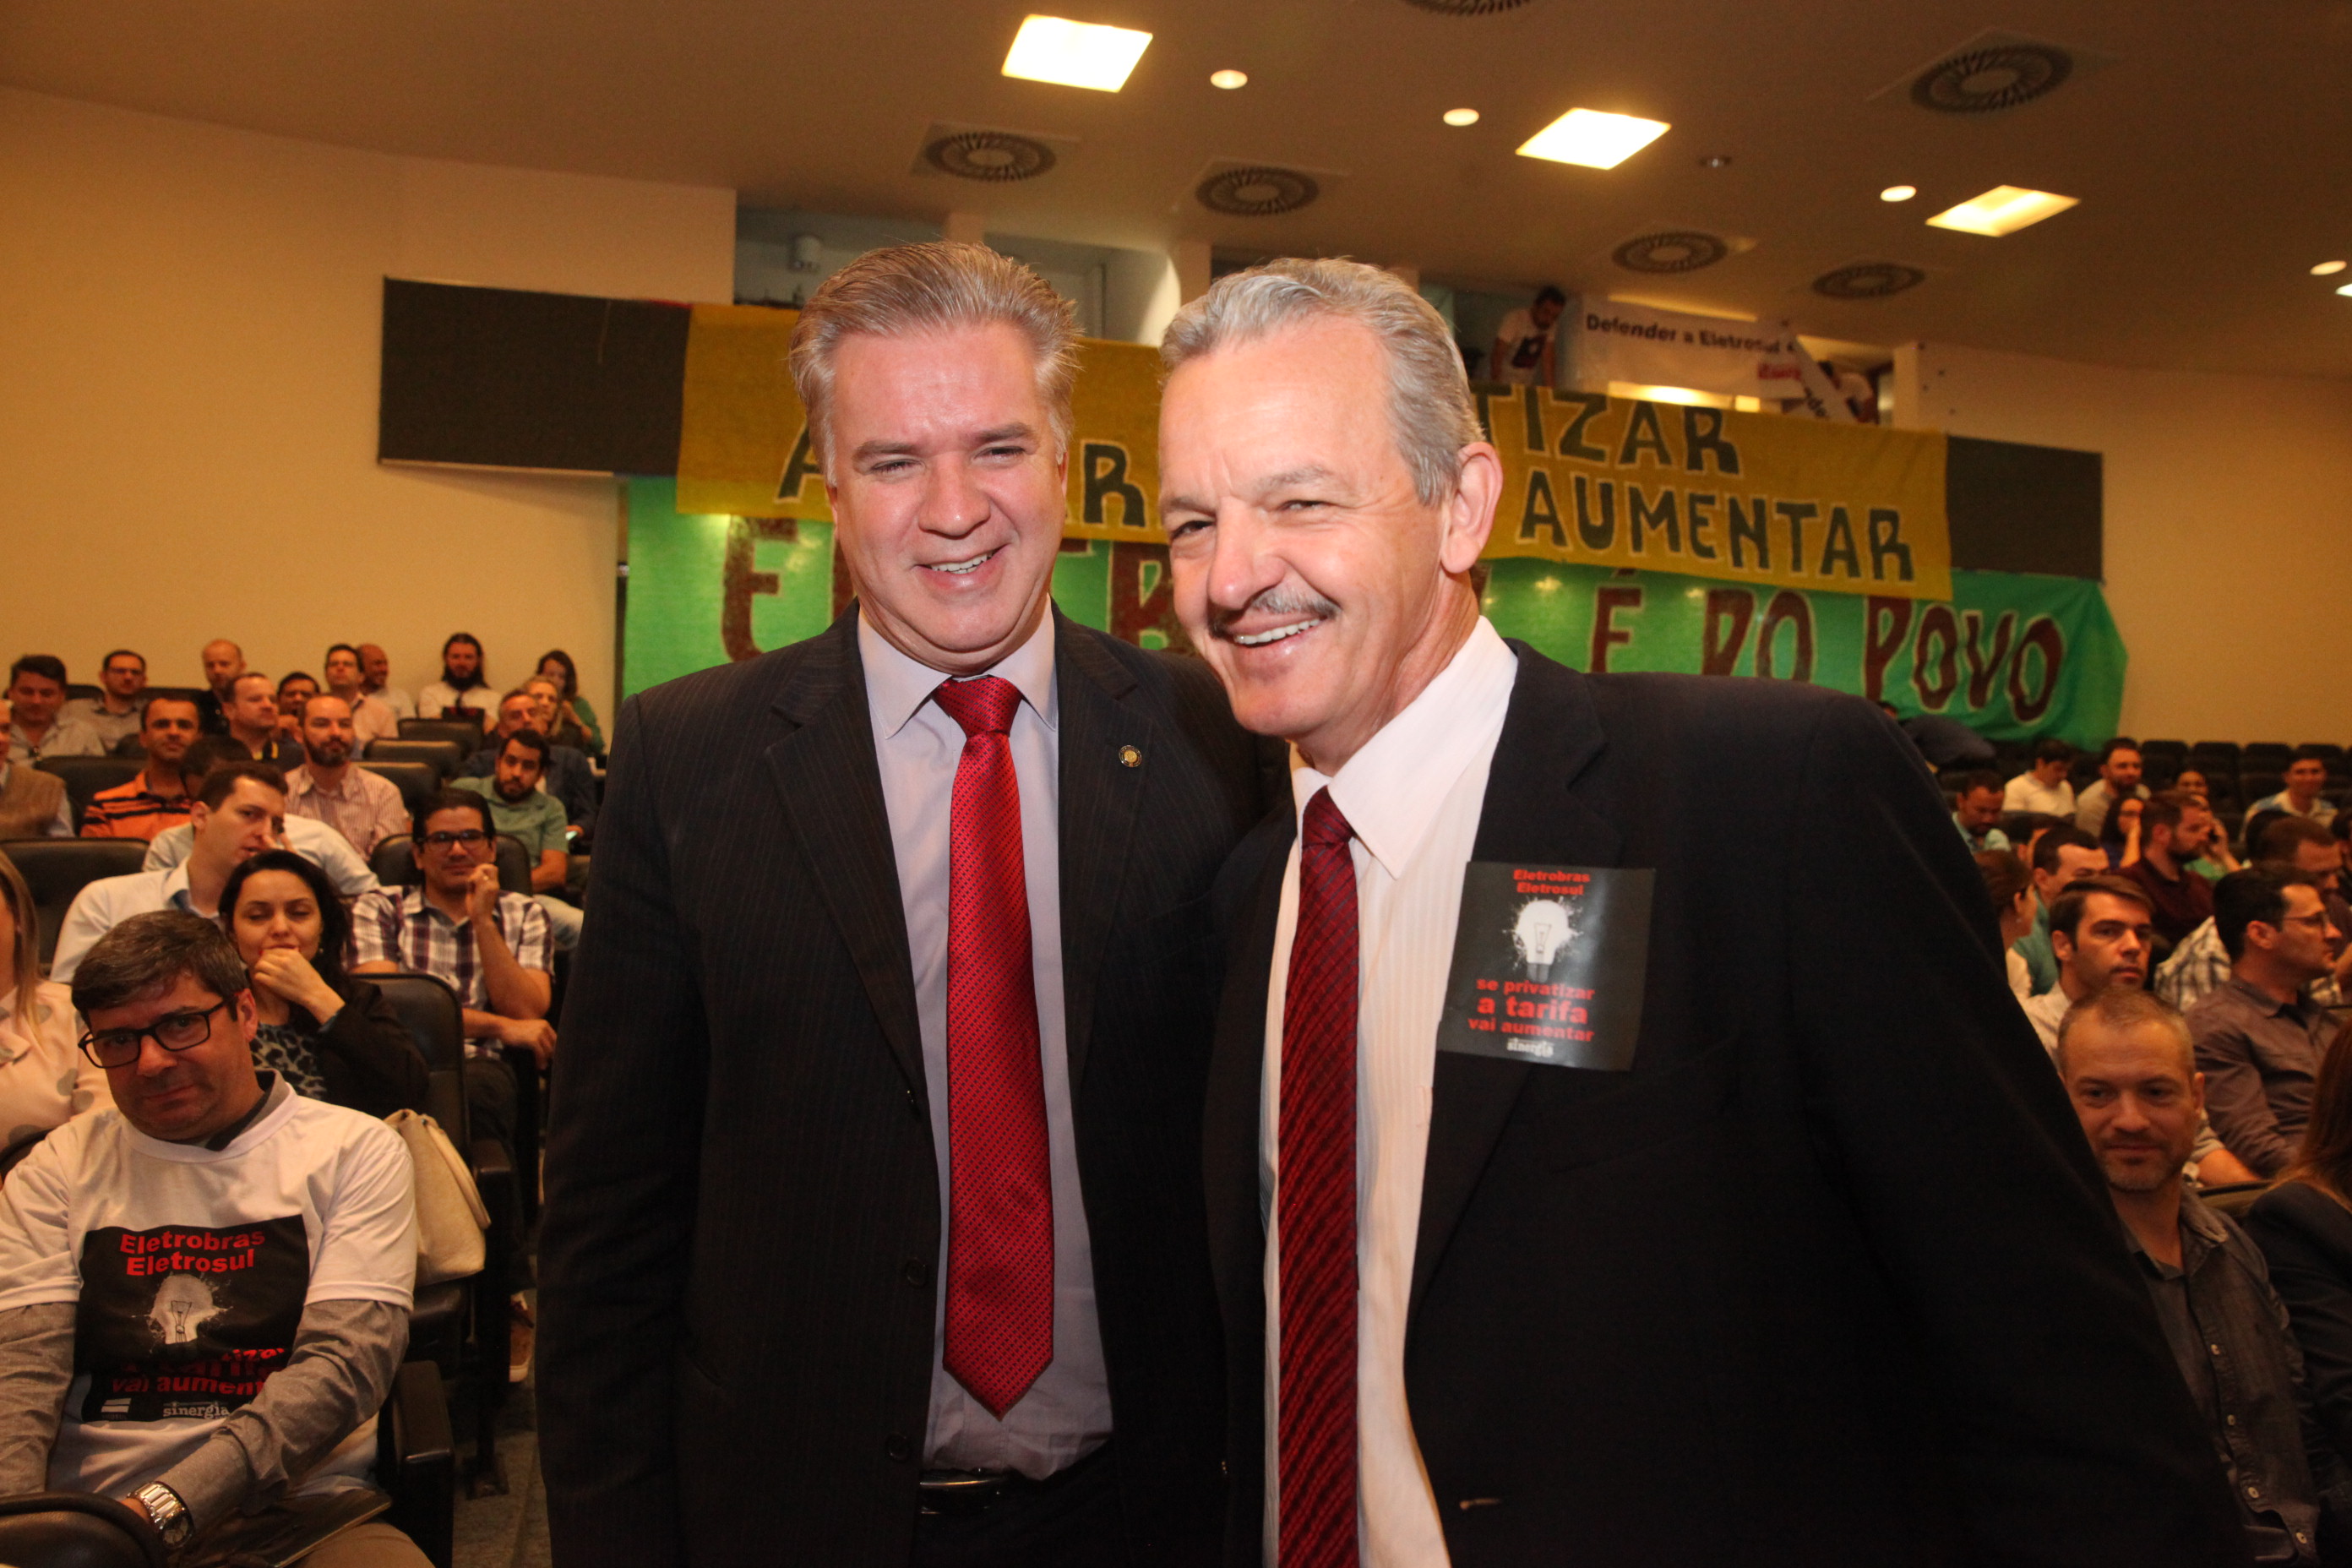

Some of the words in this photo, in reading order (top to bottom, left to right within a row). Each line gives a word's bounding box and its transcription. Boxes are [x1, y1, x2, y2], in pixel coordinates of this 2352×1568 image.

[1586, 313, 1677, 342] Defender
[1469, 382, 1741, 476] TIZAR
[1521, 469, 1916, 584] AUMENTAR
[1701, 588, 1816, 683] DO
[1862, 594, 2066, 724] POVO
[1512, 868, 1591, 884] Eletrobras
[1516, 882, 1584, 896] Eletrosul
[1476, 978, 1499, 992] se
[1503, 979, 1595, 1001] privatizar
[1477, 997, 1495, 1015] a
[1505, 996, 1588, 1025] tarifa
[1467, 1016, 1496, 1032] vai
[1500, 1020, 1595, 1043] aumentar
[1506, 1037, 1554, 1058] sinergia
[120, 1230, 266, 1255] Eletrobras
[126, 1249, 254, 1277] Eletrosul
[111, 1375, 149, 1393] vai
[155, 1375, 265, 1396] aument
[162, 1400, 231, 1419] sinergia
